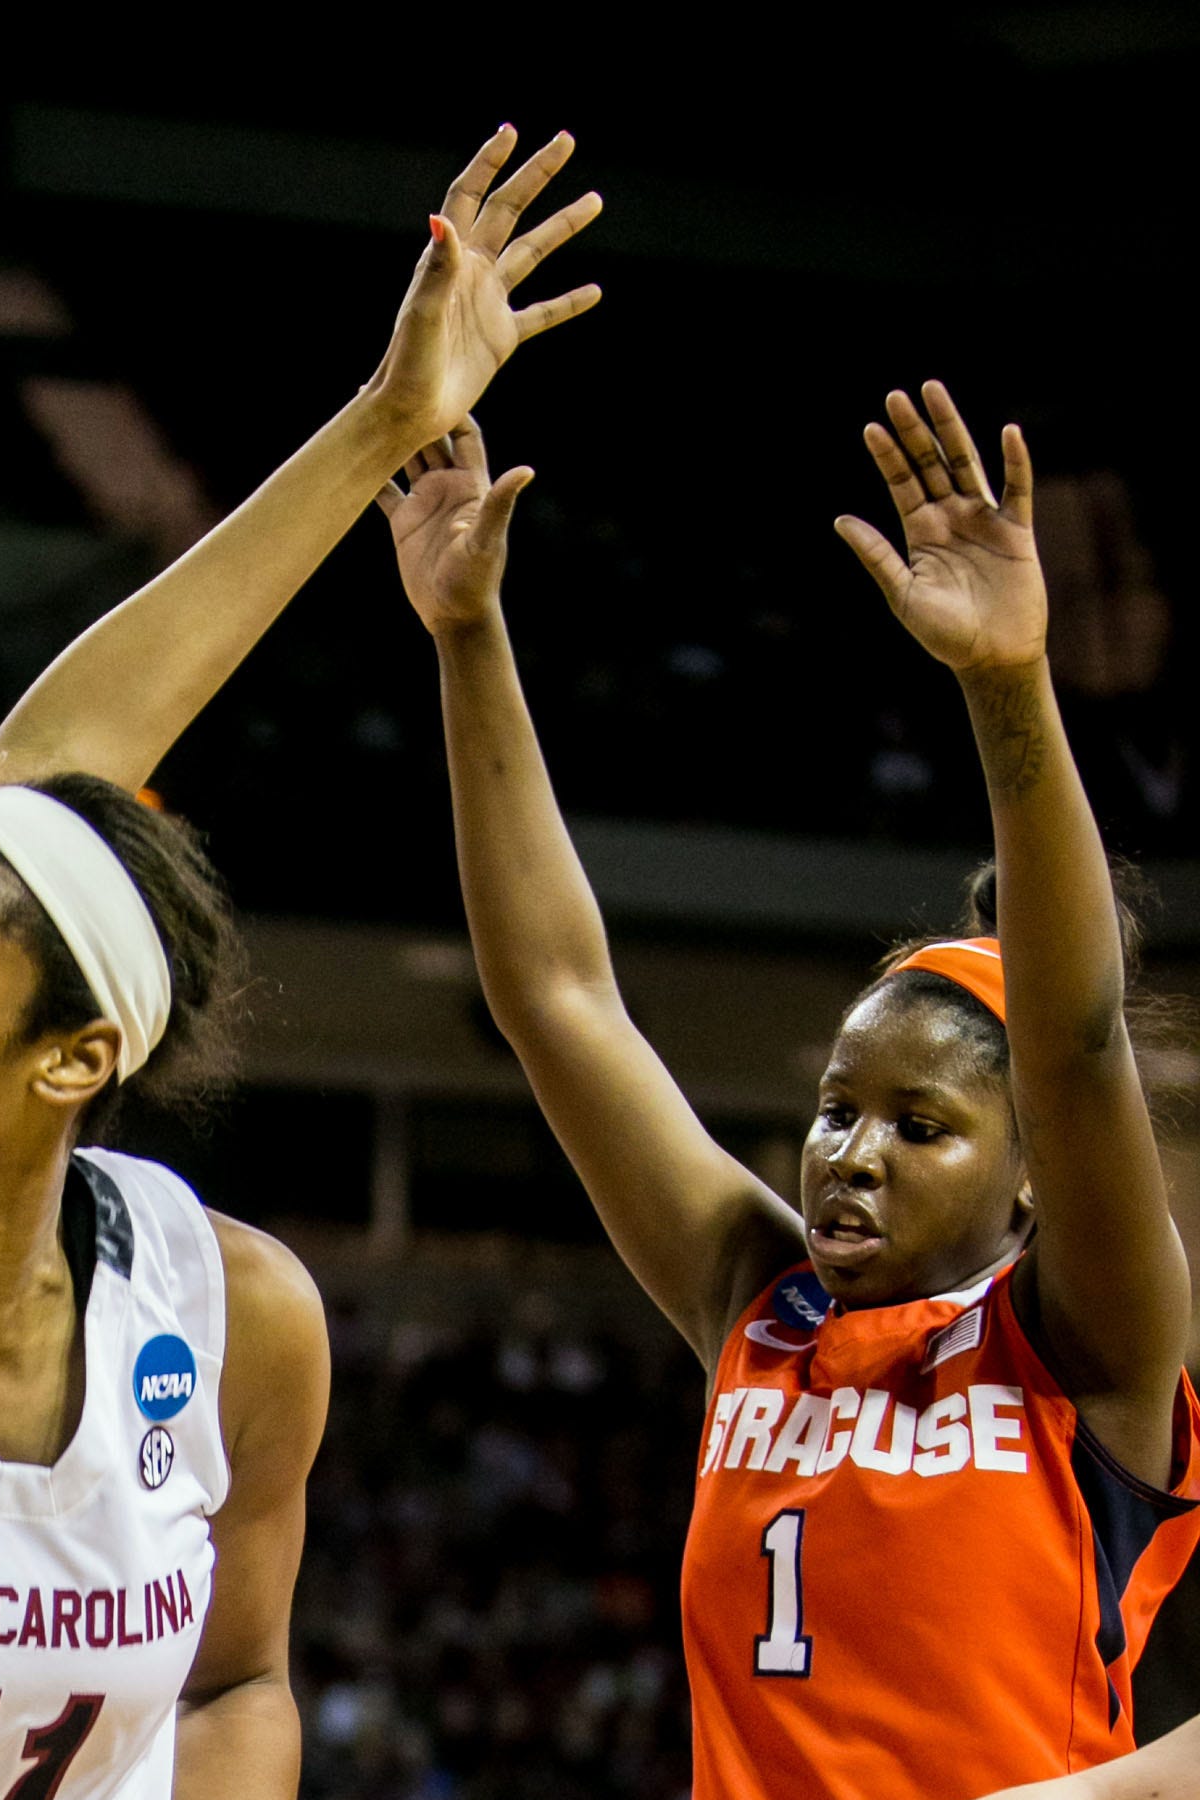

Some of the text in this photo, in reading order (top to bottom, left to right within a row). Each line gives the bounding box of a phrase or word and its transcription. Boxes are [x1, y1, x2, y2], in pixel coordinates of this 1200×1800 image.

[140, 1372, 193, 1402] NCAA
[141, 1427, 174, 1489] SEC
[699, 1384, 1029, 1479] SYRACUSE
[752, 1507, 813, 1678] 1
